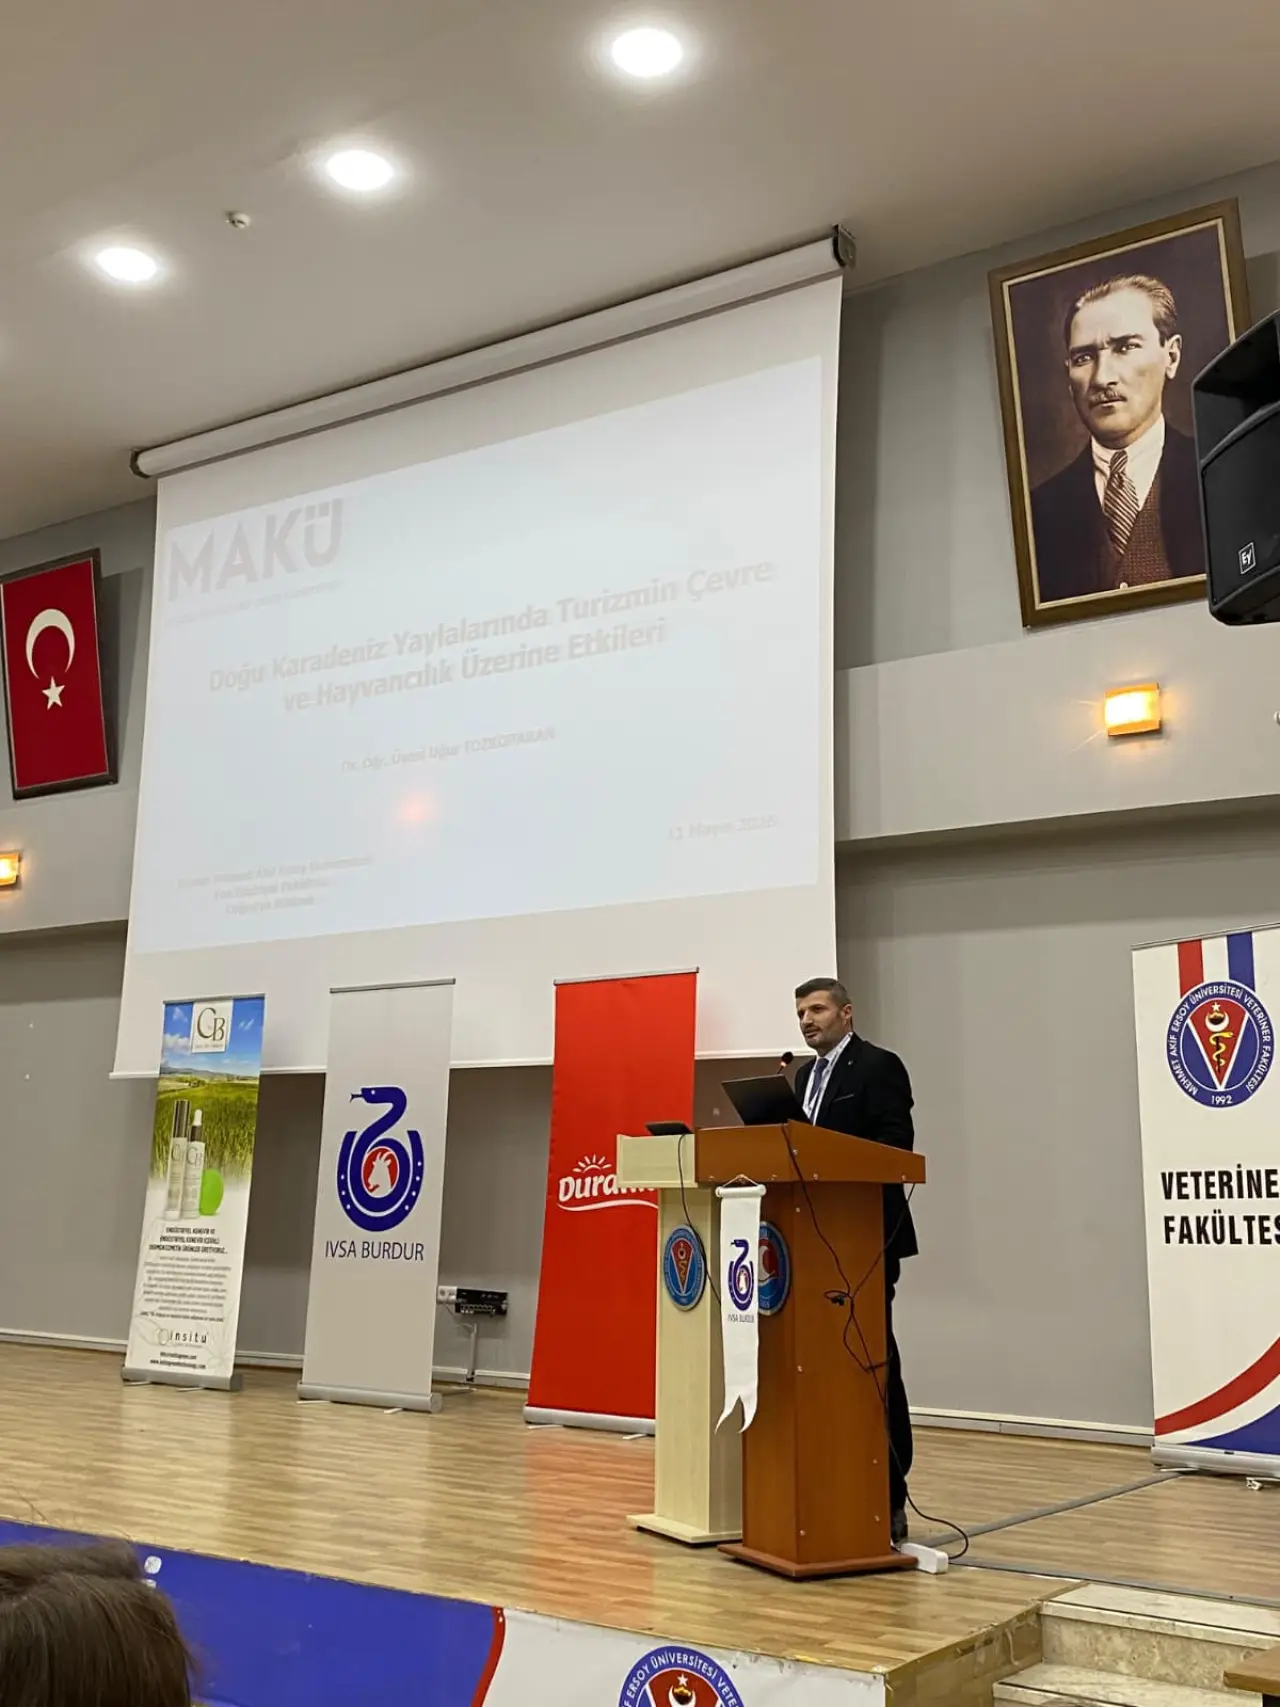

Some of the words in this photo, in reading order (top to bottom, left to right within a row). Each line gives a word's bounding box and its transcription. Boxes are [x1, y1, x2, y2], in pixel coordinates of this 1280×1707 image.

[169, 498, 343, 600] MAKÜ
[210, 661, 263, 692] Doğu
[272, 637, 389, 680] Karadeniz
[392, 603, 552, 656] Yaylalarında
[556, 578, 680, 623] Turizmin
[686, 561, 775, 601] Çevre
[284, 690, 311, 712] ve
[316, 659, 454, 708] Hayvancılık
[461, 643, 560, 681] Üzerine
[567, 617, 667, 660] Etkileri
[1189, 983, 1243, 1005] ÜNİVERSİTESİ
[1171, 1001, 1190, 1033] ERSOY
[1243, 994, 1271, 1042] VETERİNER
[1169, 1034, 1178, 1057] AKİF
[1170, 1058, 1199, 1096] MEHMET
[1245, 1045, 1271, 1093] FAKÜLTESİ
[1211, 1095, 1233, 1105] 1992
[1161, 1163, 1279, 1200] VETERİNE
[325, 1240, 357, 1259] IVSA
[361, 1241, 425, 1261] BURDUR
[626, 1664, 650, 1699] ERSOY
[651, 1652, 718, 1679] ÜNİVERSİTESİ
[717, 1676, 739, 1707] VETE
